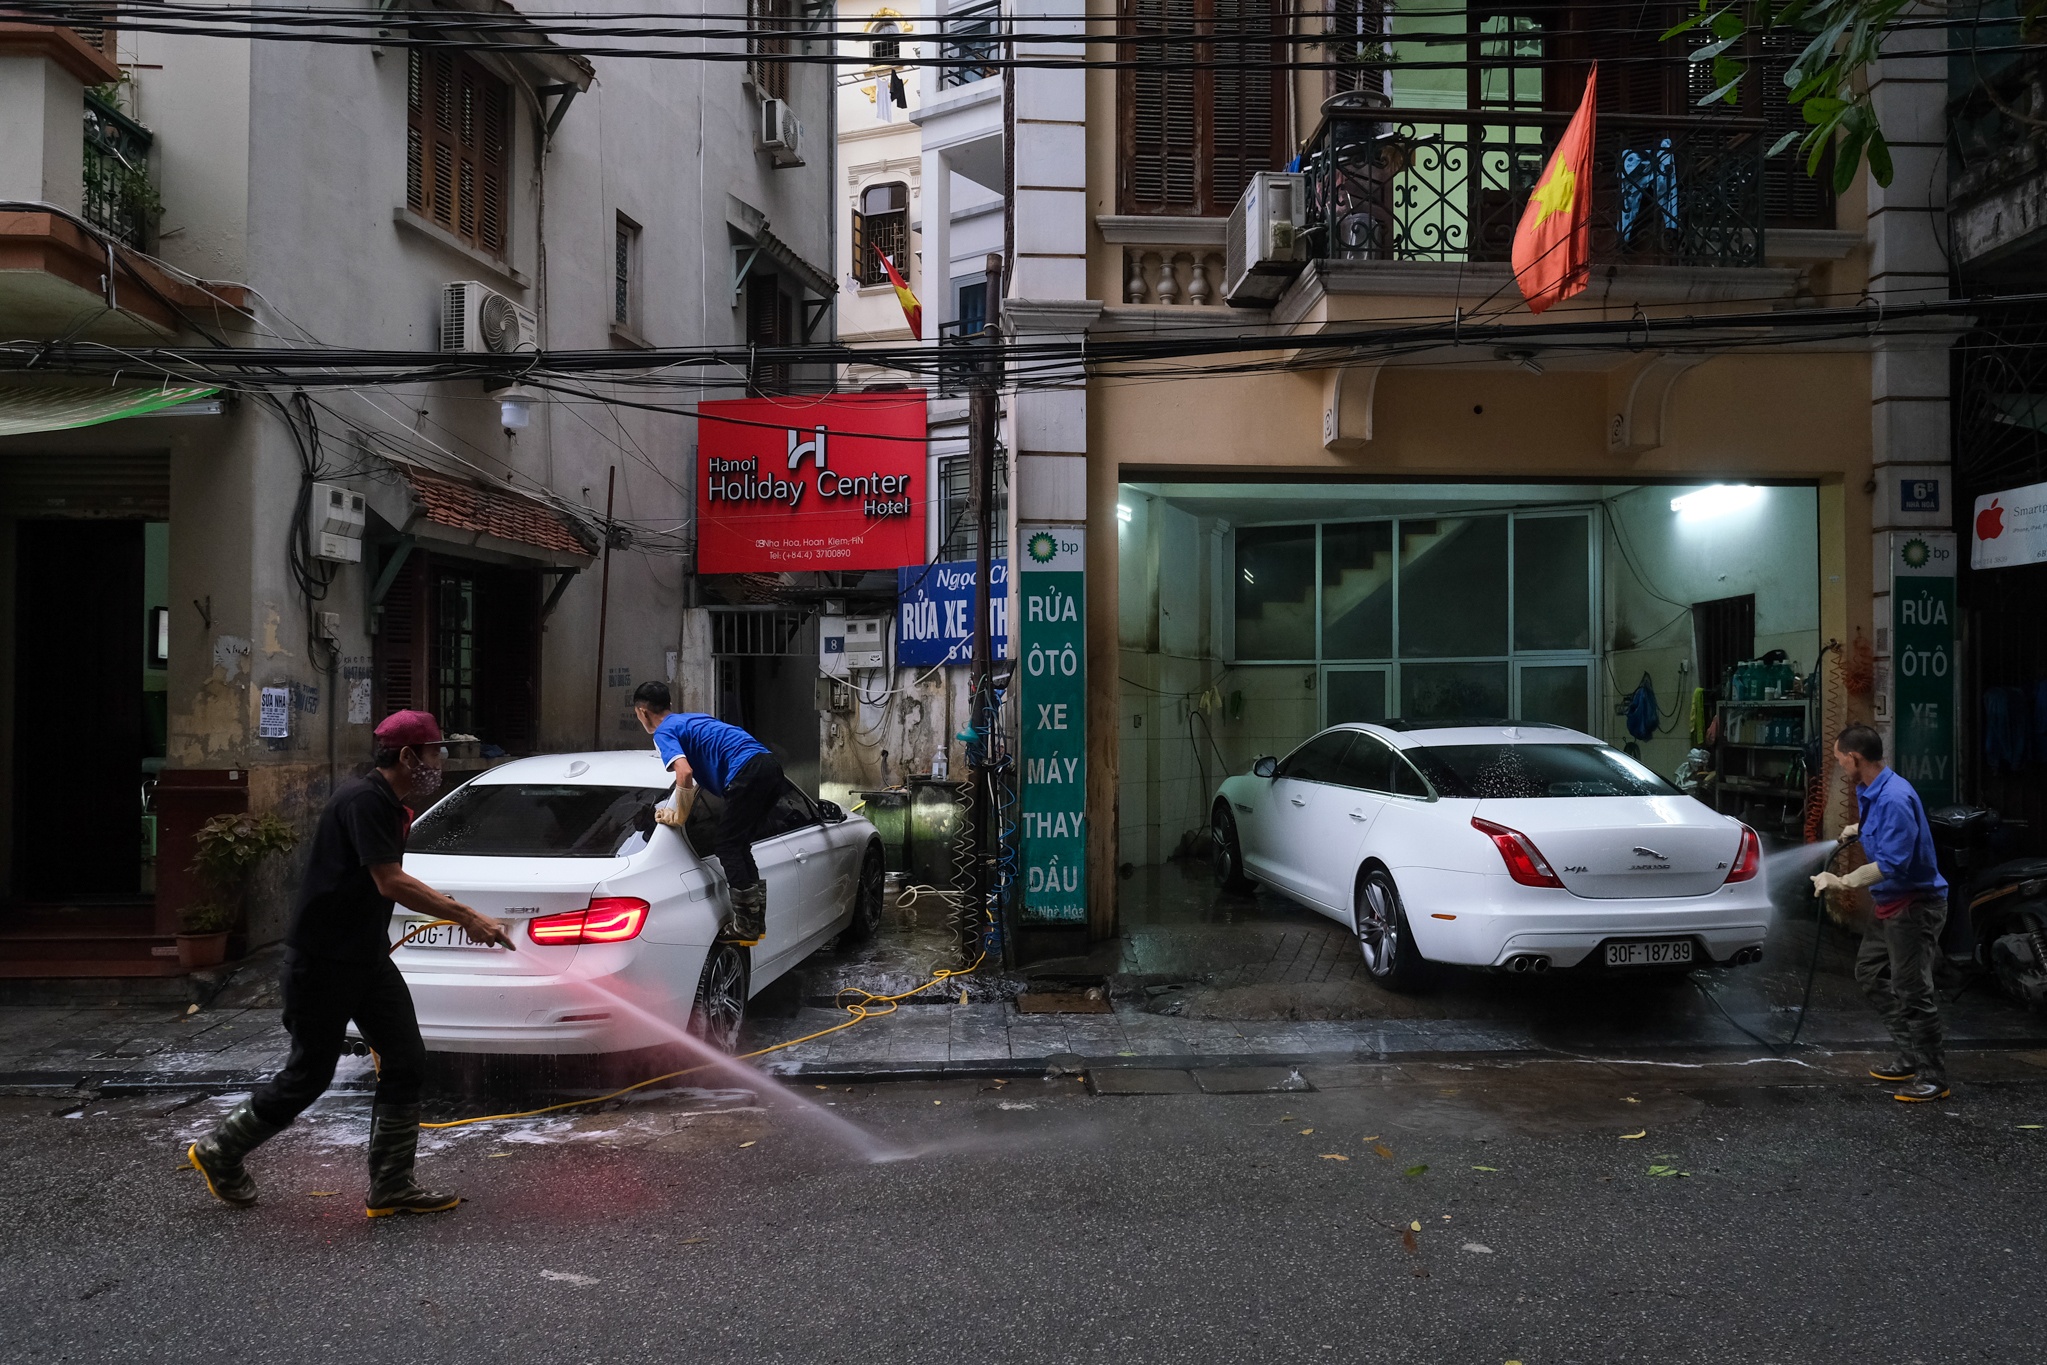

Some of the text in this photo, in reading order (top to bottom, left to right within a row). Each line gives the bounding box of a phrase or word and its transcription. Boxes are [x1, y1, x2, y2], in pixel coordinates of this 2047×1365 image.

[708, 455, 757, 473] Hanoi
[708, 470, 909, 506] Holiday Center
[864, 497, 909, 516] Hotel
[802, 537, 825, 547] Hoan
[816, 548, 851, 559] 37100890
[1061, 540, 1079, 555] bp
[1933, 547, 1950, 561] bp
[902, 588, 939, 641] RỬA
[944, 599, 968, 638] XE
[1028, 585, 1078, 622] RỬA
[1902, 590, 1948, 625] RỬA
[831, 639, 838, 650] 8
[948, 645, 958, 659] 8
[1027, 642, 1077, 677] ÔTÔ
[1901, 644, 1948, 677] ÔTÔ
[1037, 703, 1068, 730] XE
[1910, 703, 1938, 729] XE
[1027, 751, 1079, 785] MÁY
[1901, 749, 1948, 780] MÁY
[1022, 811, 1084, 839] THAY
[1028, 854, 1078, 893] DẦU
[1608, 941, 1691, 964] 30F-187.89
